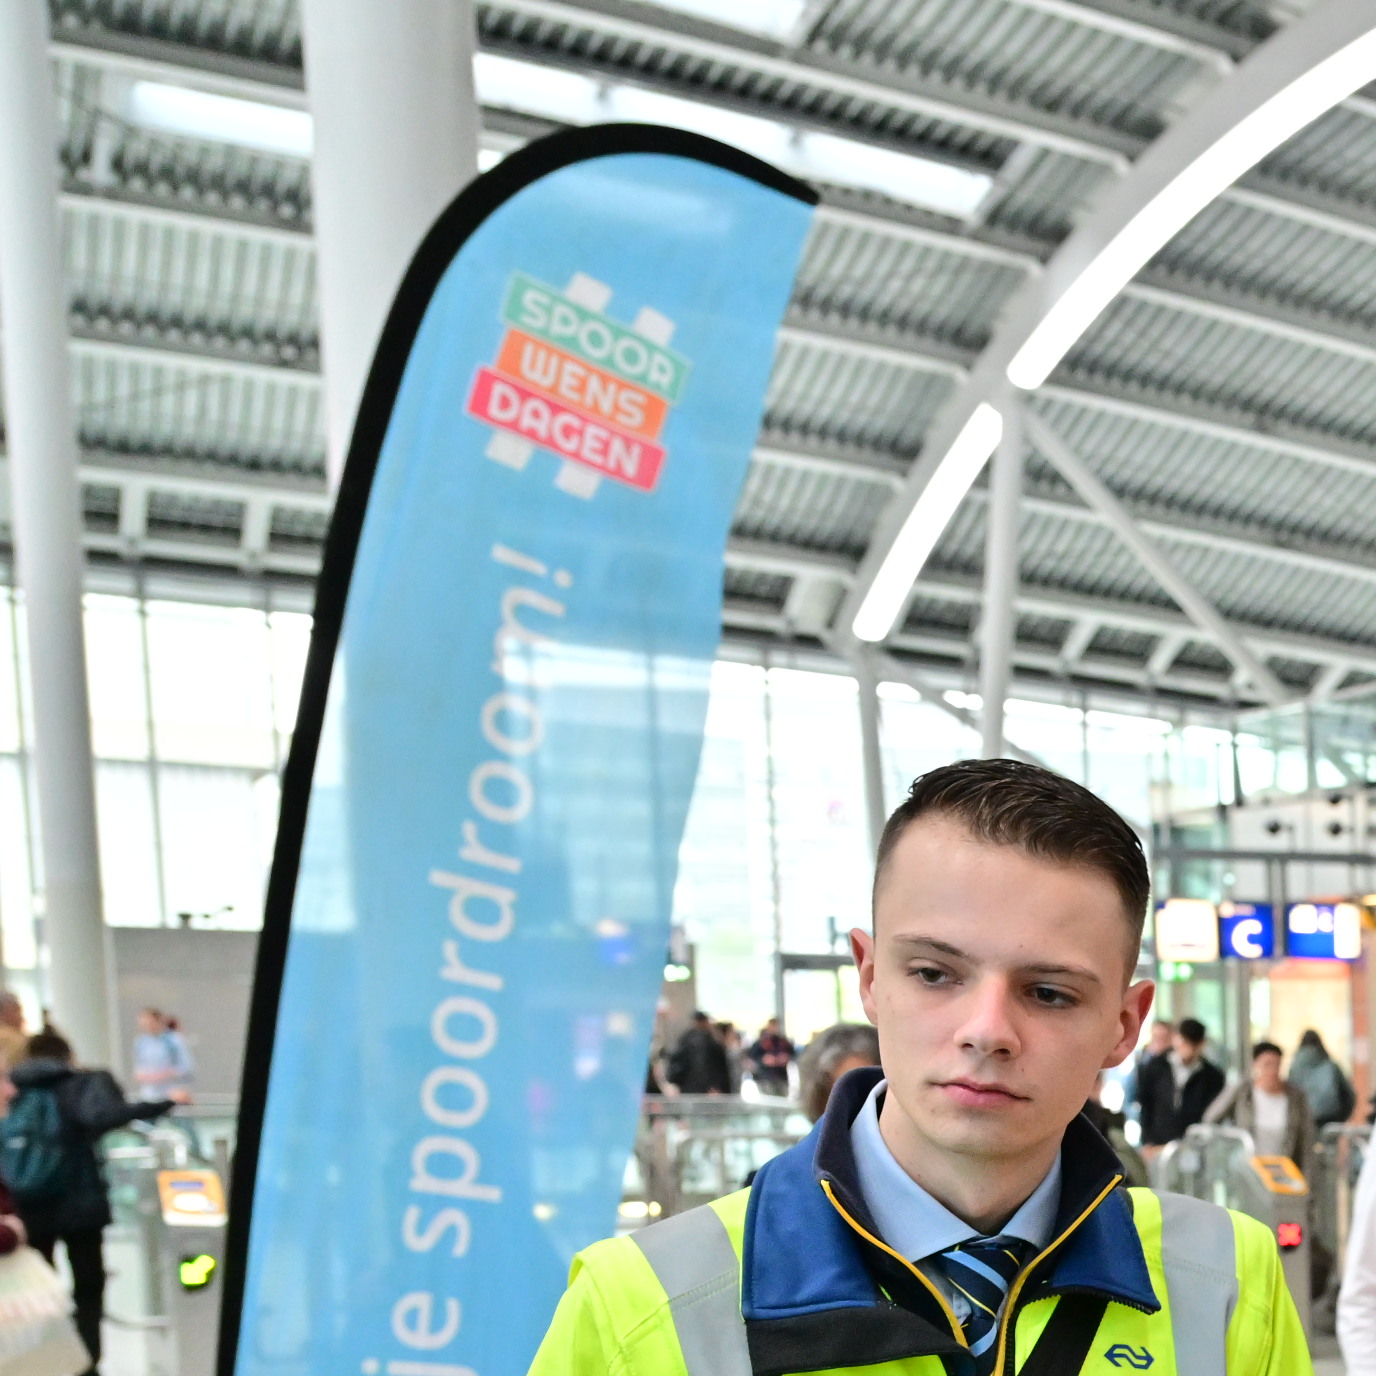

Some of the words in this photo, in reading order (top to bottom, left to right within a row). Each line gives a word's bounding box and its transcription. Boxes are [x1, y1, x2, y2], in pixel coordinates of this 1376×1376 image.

[520, 289, 675, 391] SPOOR
[520, 342, 647, 428] WENS
[486, 381, 642, 479] DAGEN
[402, 542, 574, 1258] spoordroom!
[1231, 918, 1264, 959] C
